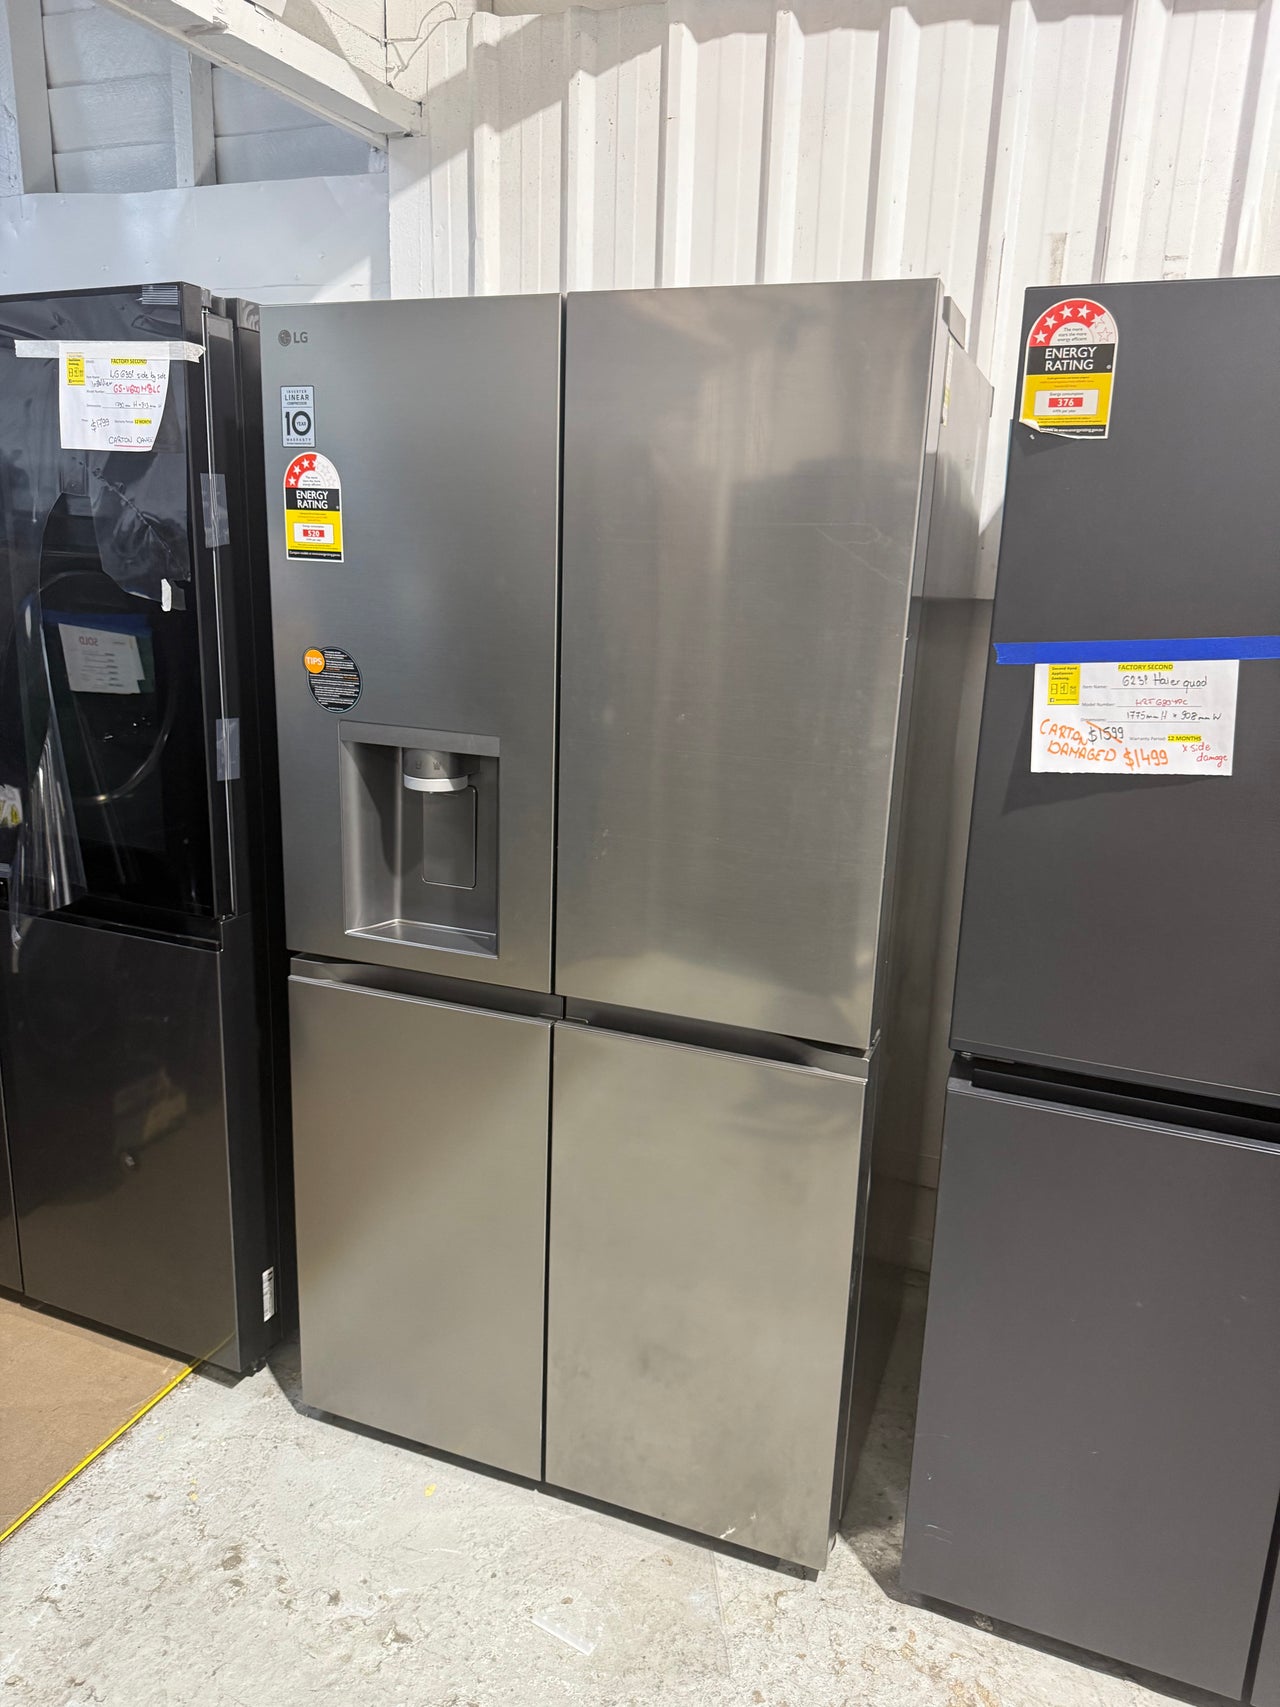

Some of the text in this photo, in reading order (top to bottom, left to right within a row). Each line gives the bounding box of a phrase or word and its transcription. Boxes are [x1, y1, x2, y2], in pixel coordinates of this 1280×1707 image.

[294, 332, 308, 344] LG
[1045, 346, 1097, 359] ENERGY
[1045, 360, 1094, 372] RATING
[110, 370, 119, 378] LG
[1057, 399, 1074, 407] 376
[285, 410, 311, 436] 10
[296, 490, 328, 500] ENERGY
[297, 500, 328, 509] RATING
[305, 656, 323, 666] TIPS
[1153, 672, 1180, 686] Haier
[1183, 676, 1207, 694] quad
[1161, 710, 1167, 720] H
[1040, 718, 1088, 746] CARTON
[1191, 742, 1211, 752] side
[1047, 740, 1169, 771] DAMAGED $1499
[1196, 752, 1228, 768] damage
